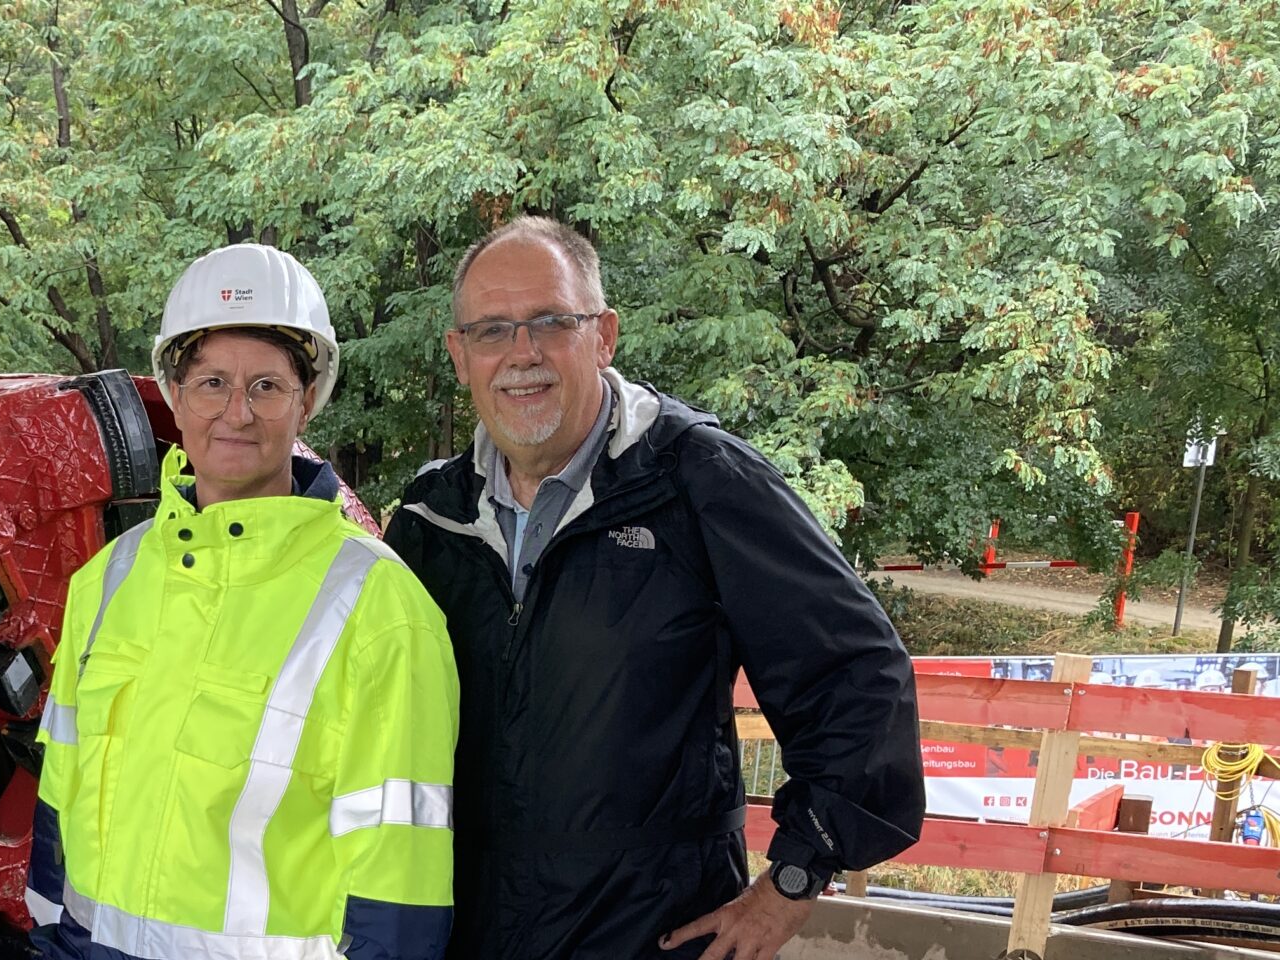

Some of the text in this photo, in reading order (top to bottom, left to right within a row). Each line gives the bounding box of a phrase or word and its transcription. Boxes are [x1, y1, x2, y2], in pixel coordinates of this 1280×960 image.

[622, 526, 640, 534] THE
[608, 530, 640, 541] NORTH
[616, 538, 640, 548] FACE
[1087, 767, 1115, 780] Die
